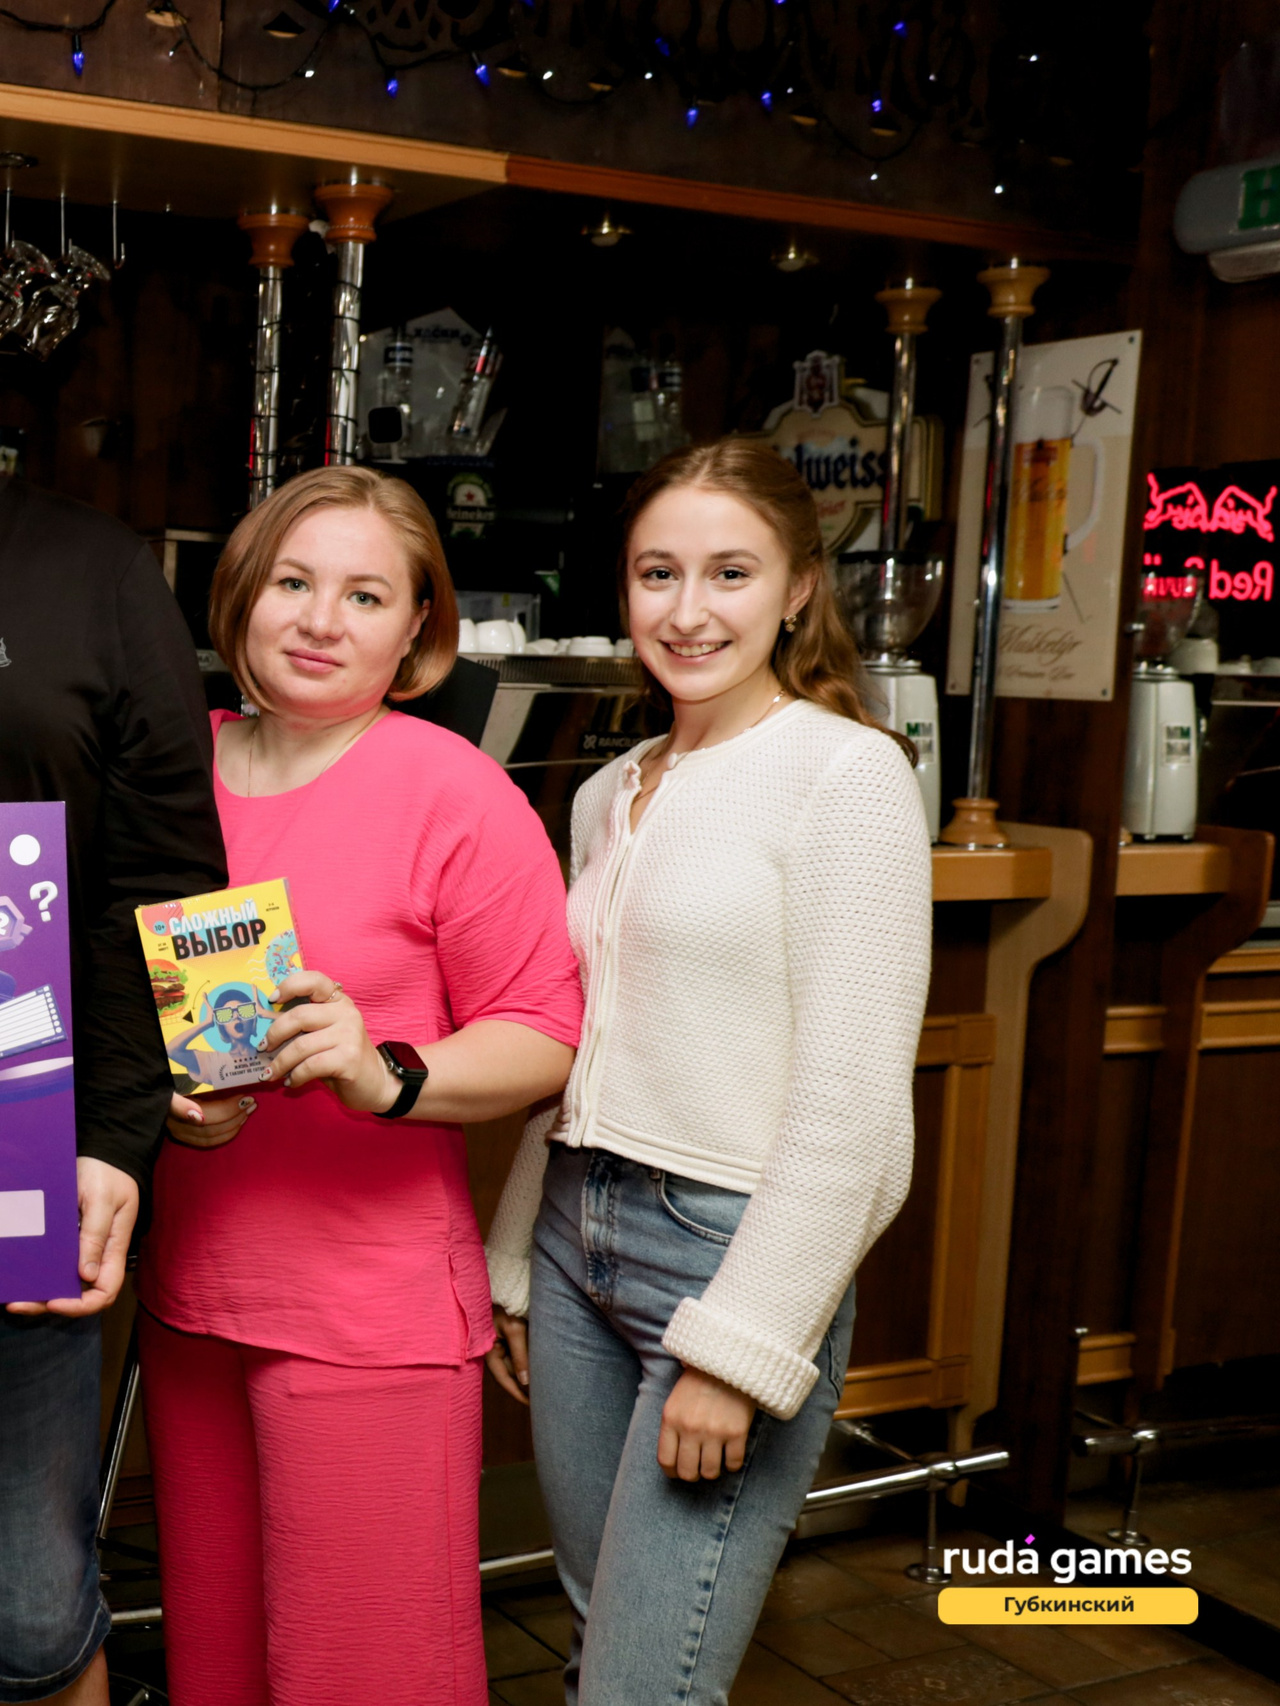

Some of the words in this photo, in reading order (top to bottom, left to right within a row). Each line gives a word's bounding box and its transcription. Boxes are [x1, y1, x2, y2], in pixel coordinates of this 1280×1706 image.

[154, 923, 166, 932] 10+
[168, 898, 259, 936] СЛОЖНЫЙ
[171, 918, 267, 961] ВЫБОР
